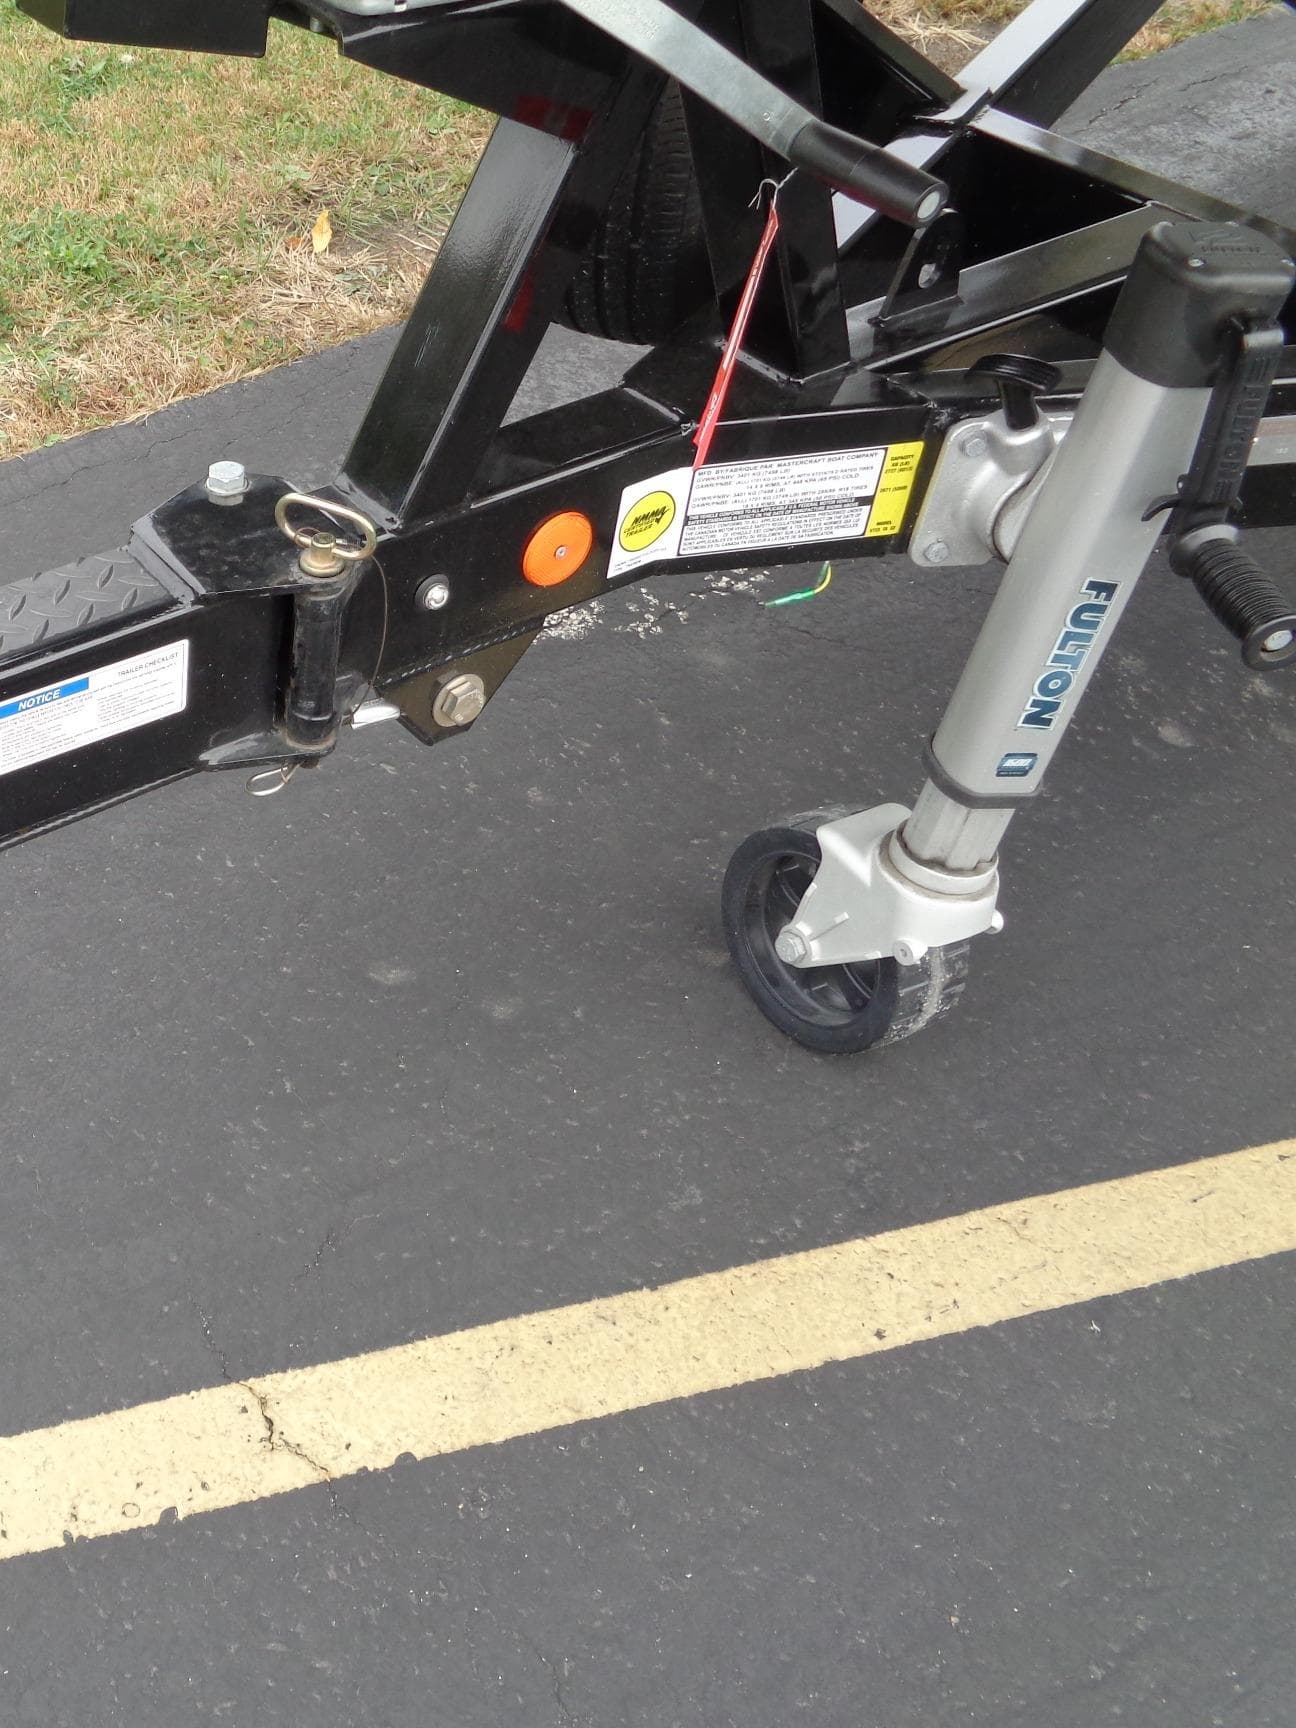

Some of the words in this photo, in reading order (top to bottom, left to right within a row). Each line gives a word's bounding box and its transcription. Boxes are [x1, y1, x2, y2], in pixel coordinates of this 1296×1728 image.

[776, 458, 825, 467] MASTERCRAFT
[144, 652, 180, 669] CHECKLIST
[1019, 578, 1119, 729] FULTON
[17, 688, 62, 711] NOTICE
